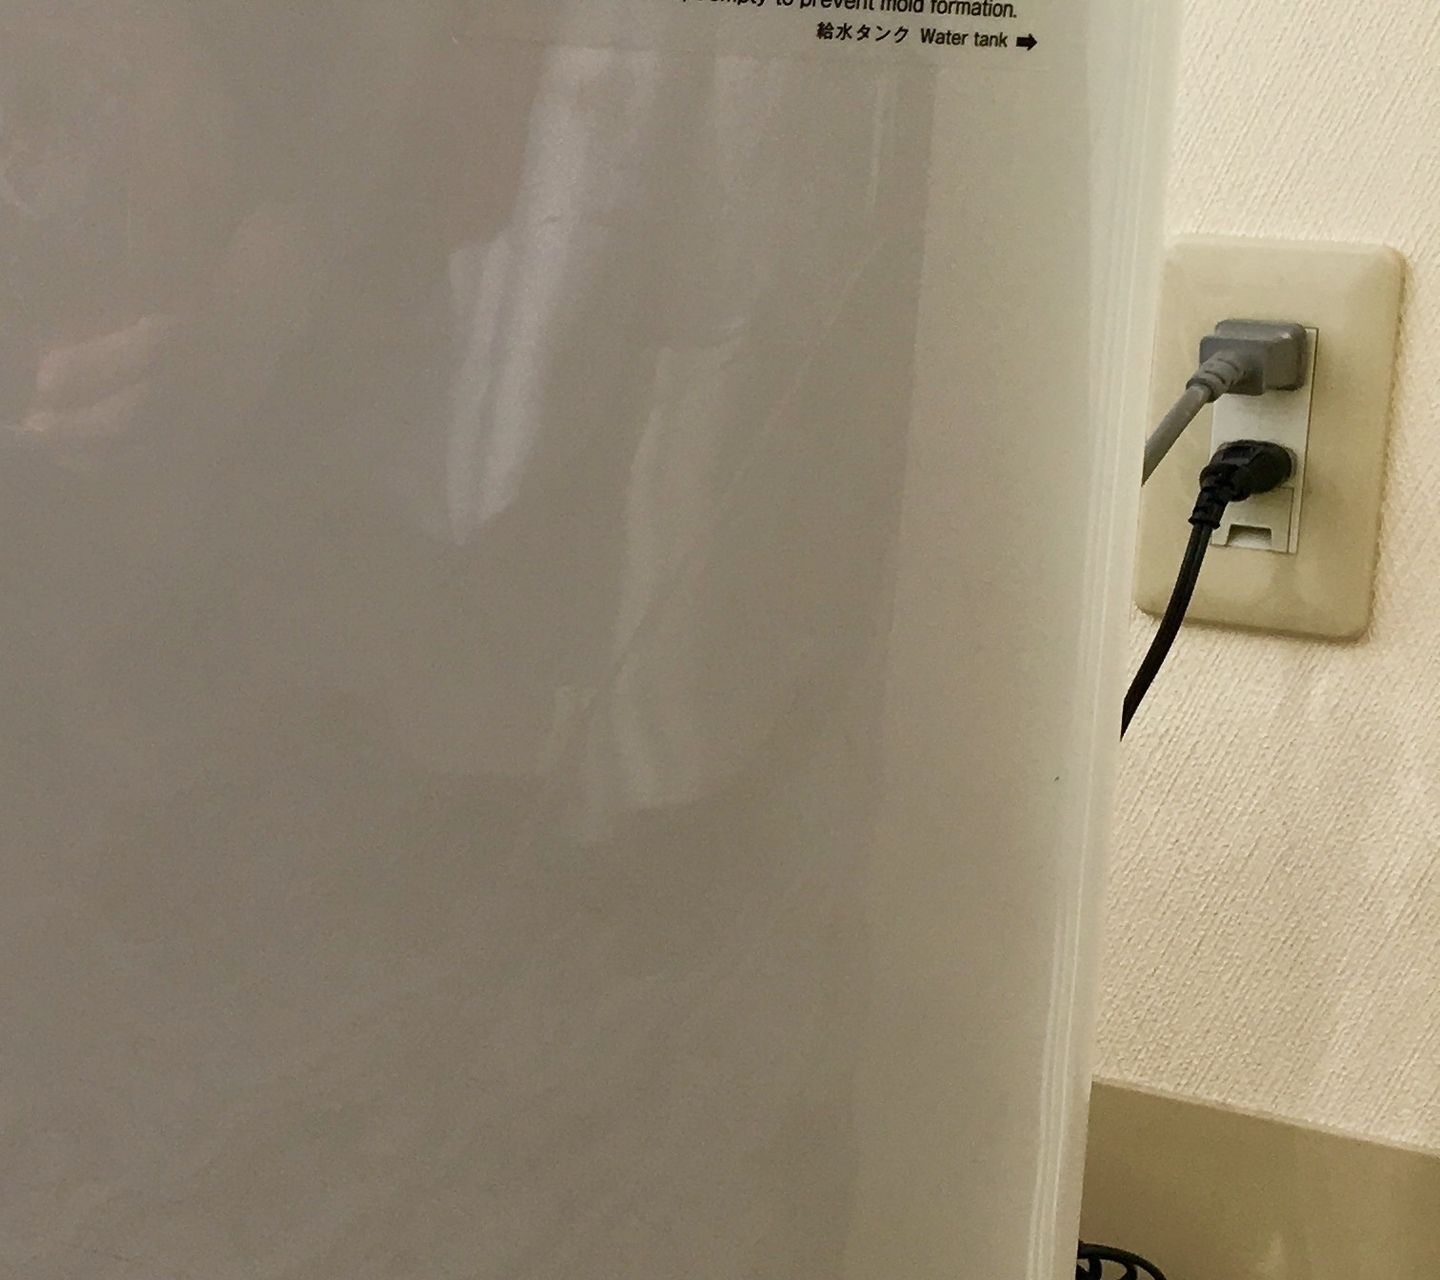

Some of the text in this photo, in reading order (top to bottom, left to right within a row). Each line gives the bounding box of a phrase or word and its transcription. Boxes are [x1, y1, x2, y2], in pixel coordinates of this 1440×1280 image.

[816, 22, 1008, 49] 給水タンク Water tank
